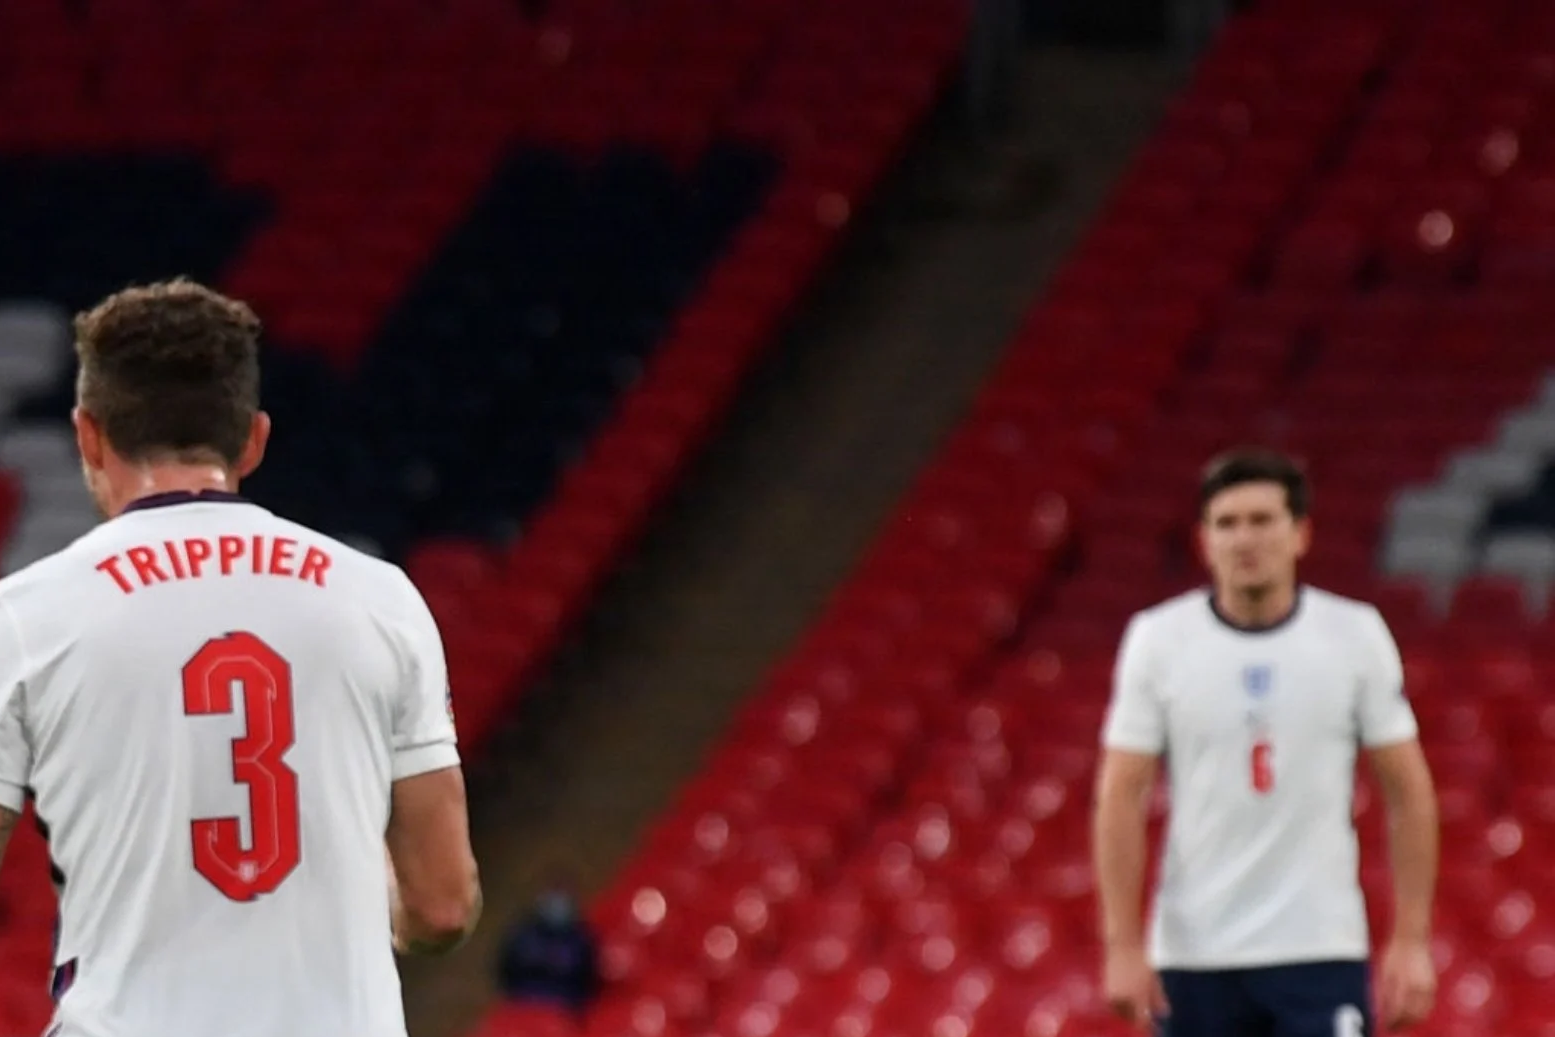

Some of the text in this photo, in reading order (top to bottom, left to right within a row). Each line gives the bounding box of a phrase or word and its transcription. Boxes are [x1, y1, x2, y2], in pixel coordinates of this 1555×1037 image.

[95, 535, 333, 595] TRIPPIER
[181, 630, 301, 902] 3
[1249, 742, 1275, 795] 6
